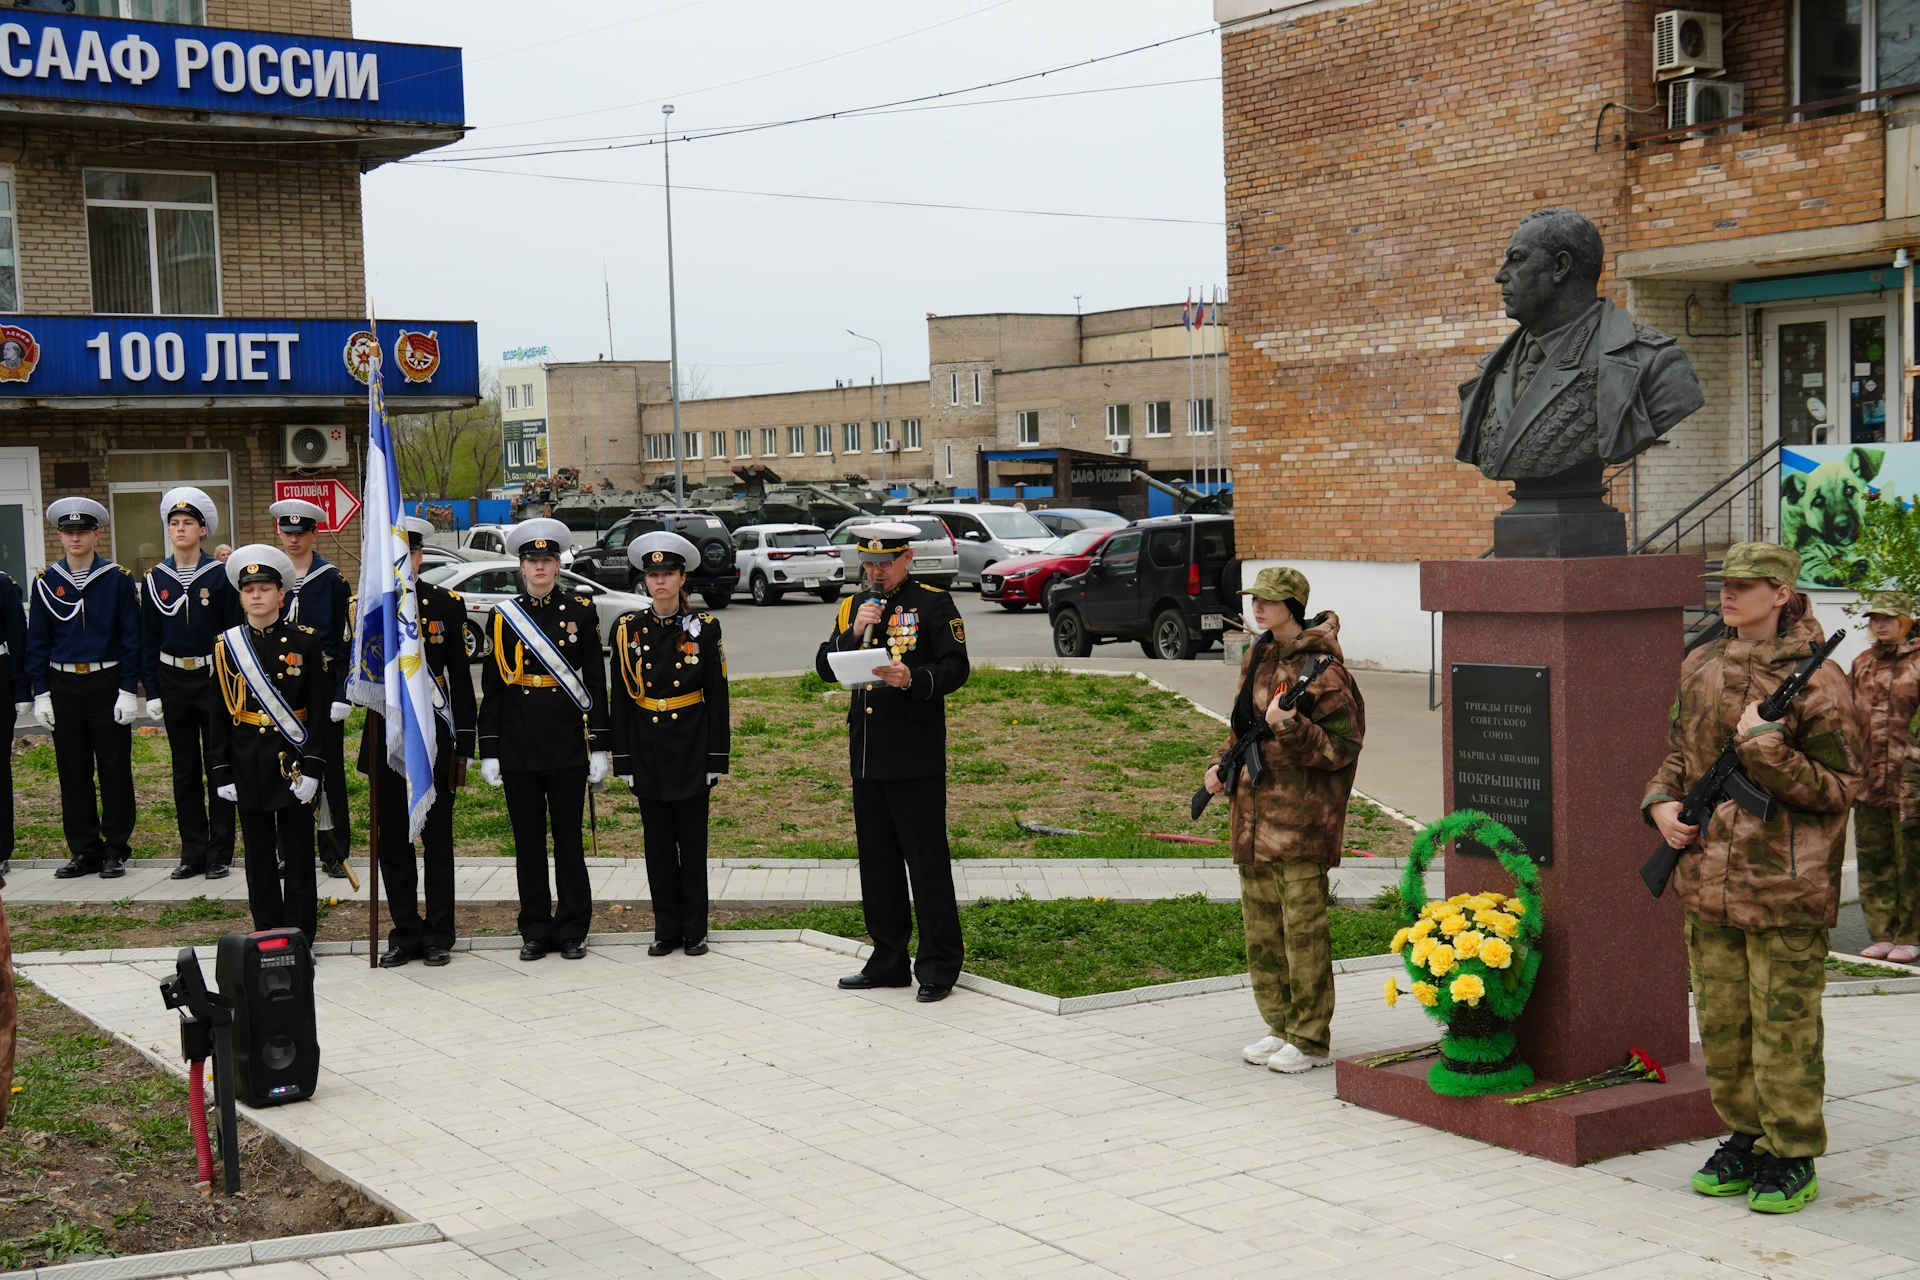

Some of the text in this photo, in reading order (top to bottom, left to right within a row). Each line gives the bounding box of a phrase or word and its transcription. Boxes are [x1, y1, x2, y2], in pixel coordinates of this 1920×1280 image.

[0, 22, 380, 102] СААФ РОССИИ
[6, 330, 30, 344] ЛЕНИН
[86, 331, 300, 382] 100 ЛЕТ
[283, 485, 329, 498] СТОЛОВАЯ
[1464, 701, 1532, 714] ТРИЖДЫ ГЕРОЙ
[1470, 715, 1527, 728] СОВЕТСКОГО
[1483, 729, 1514, 740] СОЮЗА
[1459, 749, 1540, 765] МАРШАЛ АВИАЦИИ
[1458, 771, 1541, 791] ПОКРЫШКИН
[1470, 793, 1530, 808] АЛЕКСАНДР
[1486, 812, 1528, 825] НОВИЧ
